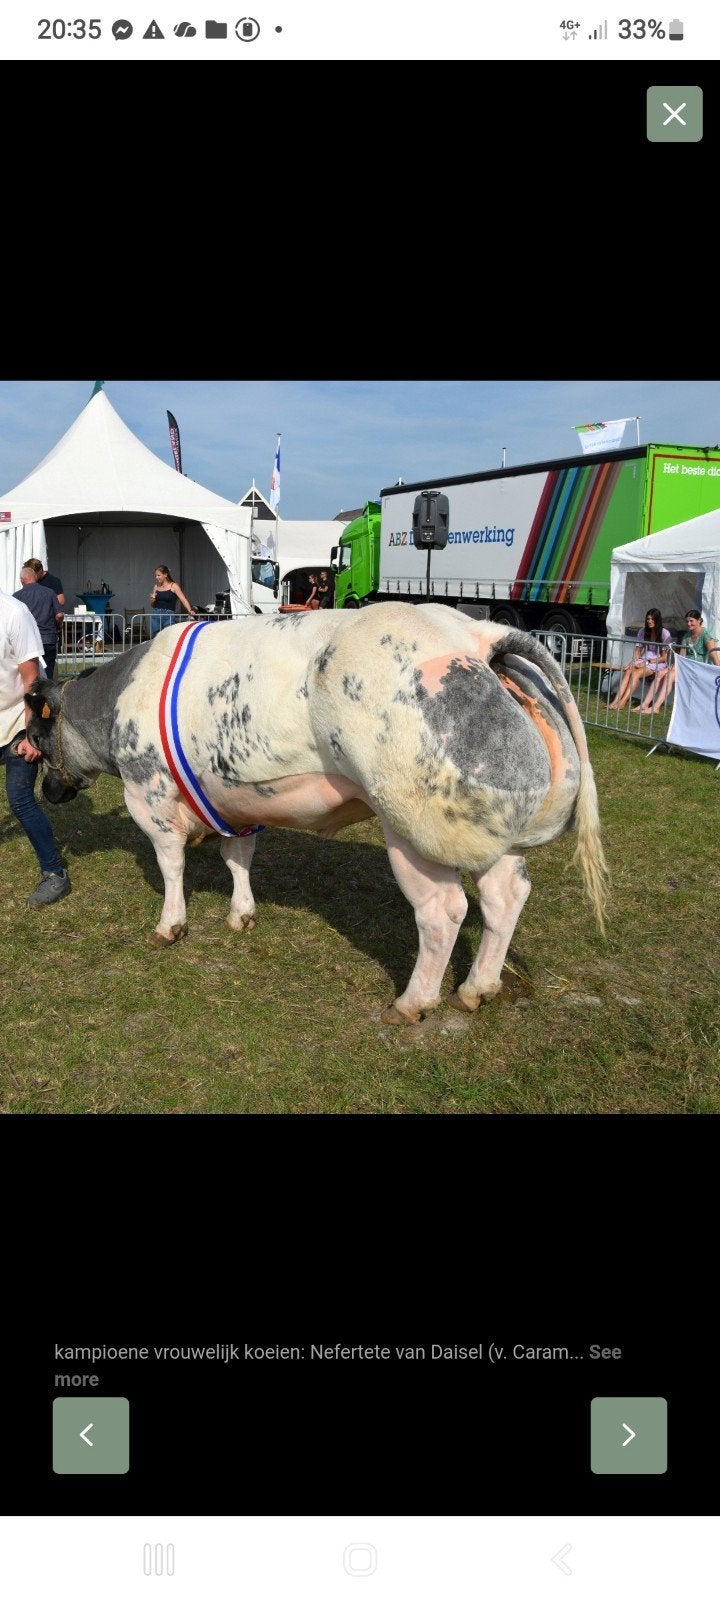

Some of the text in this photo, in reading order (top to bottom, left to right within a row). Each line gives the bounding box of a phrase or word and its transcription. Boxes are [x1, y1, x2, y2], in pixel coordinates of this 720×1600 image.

[663, 462, 679, 474] Het
[681, 465, 705, 476] beste
[389, 531, 408, 546] ABZ
